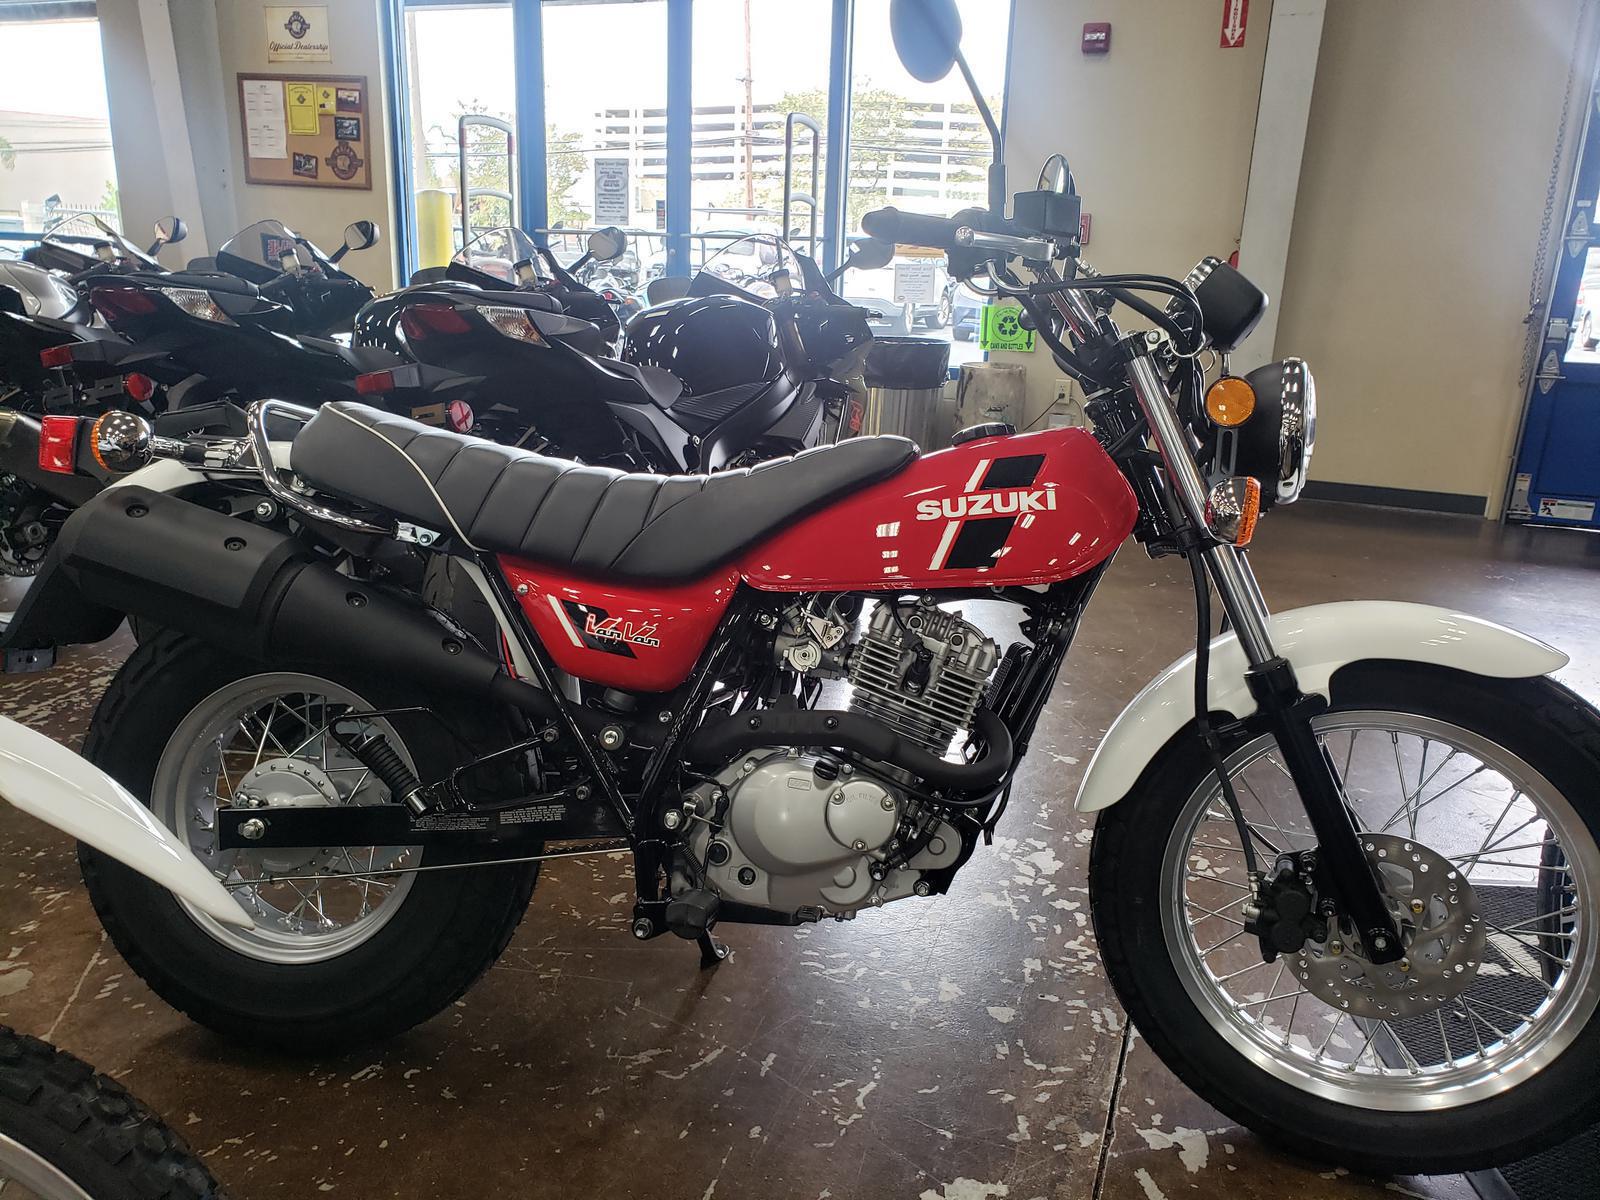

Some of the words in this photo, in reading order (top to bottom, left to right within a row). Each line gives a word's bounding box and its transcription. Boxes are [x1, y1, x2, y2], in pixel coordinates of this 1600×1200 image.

[269, 41, 294, 52] Official
[294, 40, 329, 52] Dealership
[915, 488, 1057, 521] SUZUKI
[586, 613, 623, 640] Van
[623, 621, 660, 648] Van
